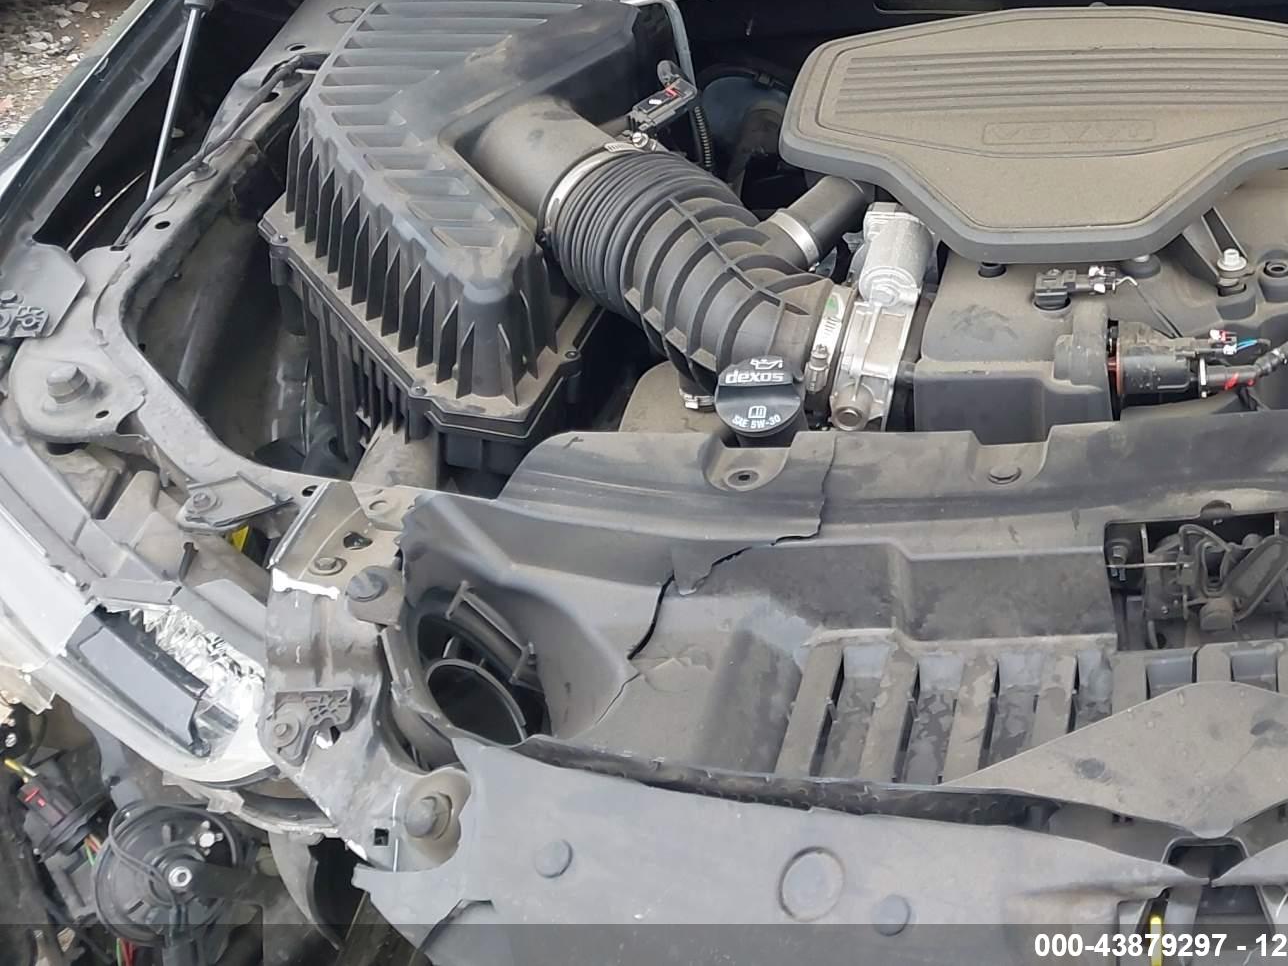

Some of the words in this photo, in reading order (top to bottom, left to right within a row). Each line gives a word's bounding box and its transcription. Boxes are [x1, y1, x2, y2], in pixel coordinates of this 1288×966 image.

[725, 369, 784, 384] dexos
[732, 415, 750, 428] SAE
[750, 414, 781, 429] 5W-30
